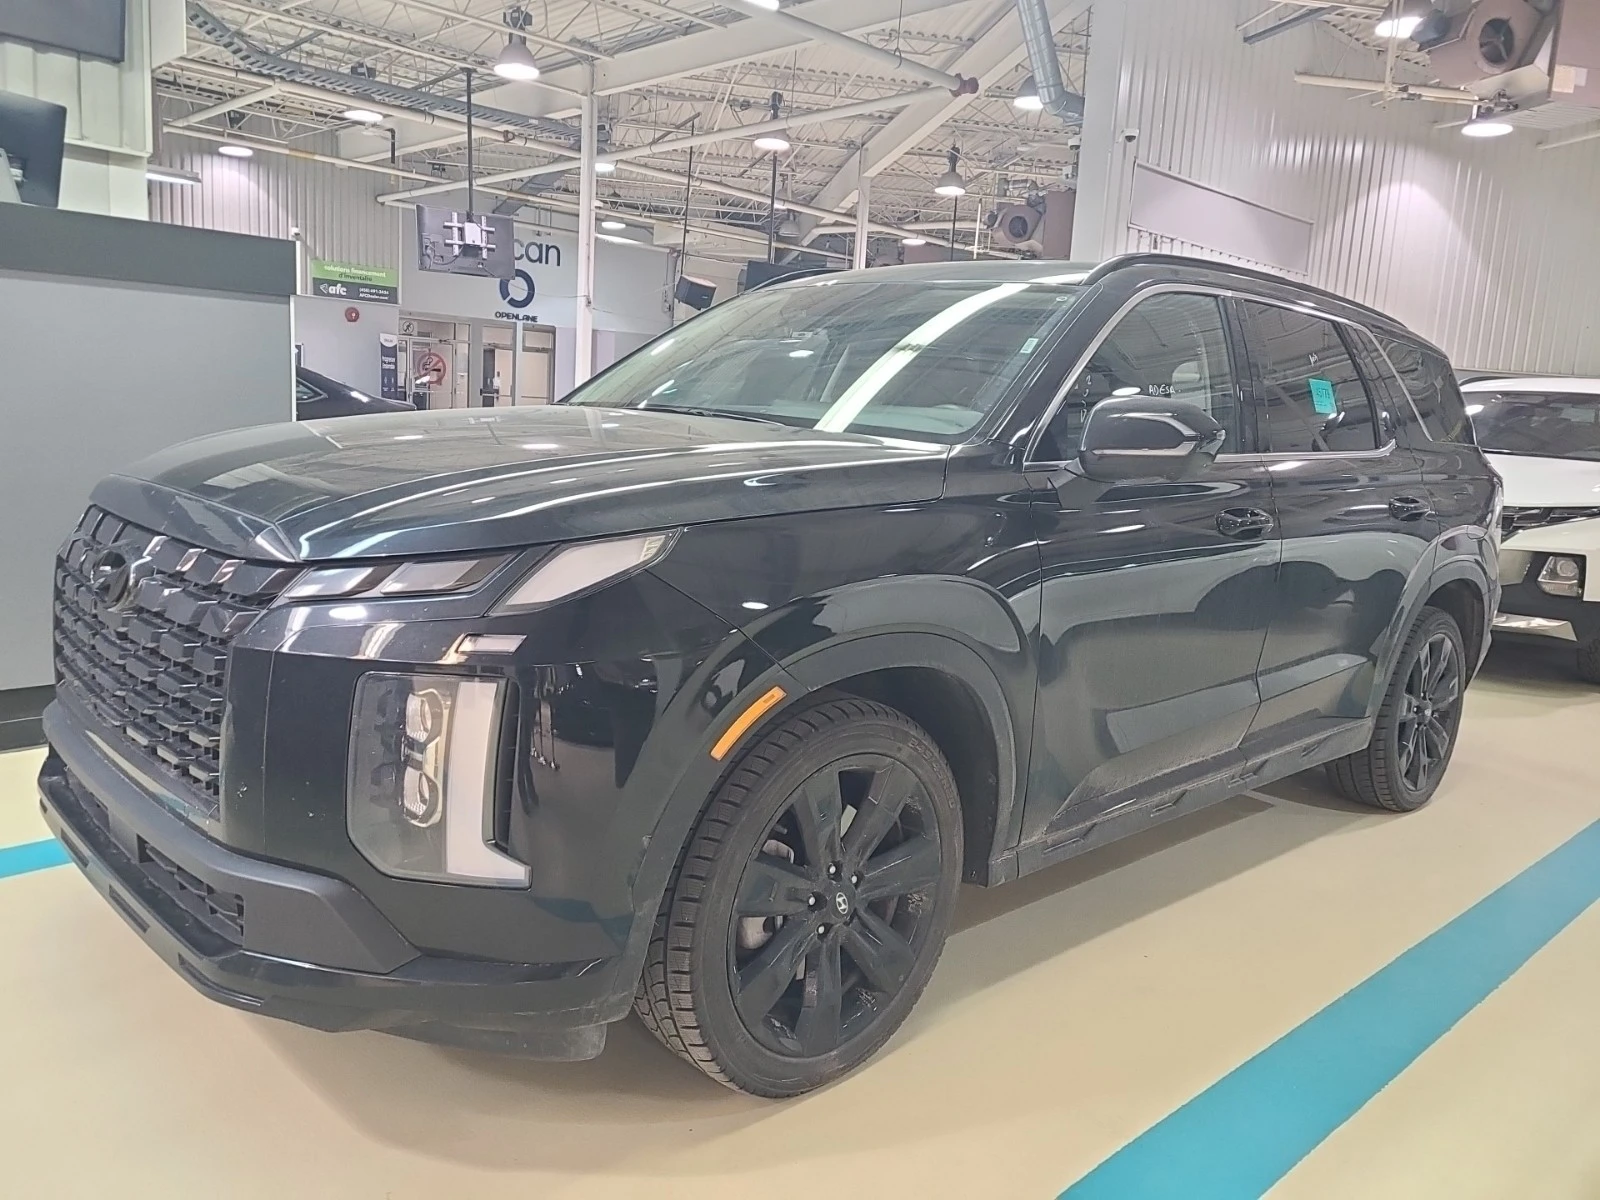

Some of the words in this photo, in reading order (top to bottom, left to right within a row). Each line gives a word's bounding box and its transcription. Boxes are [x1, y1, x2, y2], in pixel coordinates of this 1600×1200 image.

[324, 265, 350, 274] solutions
[351, 267, 387, 278] financement
[328, 283, 348, 297] afc
[494, 311, 538, 323] OPENLANE
